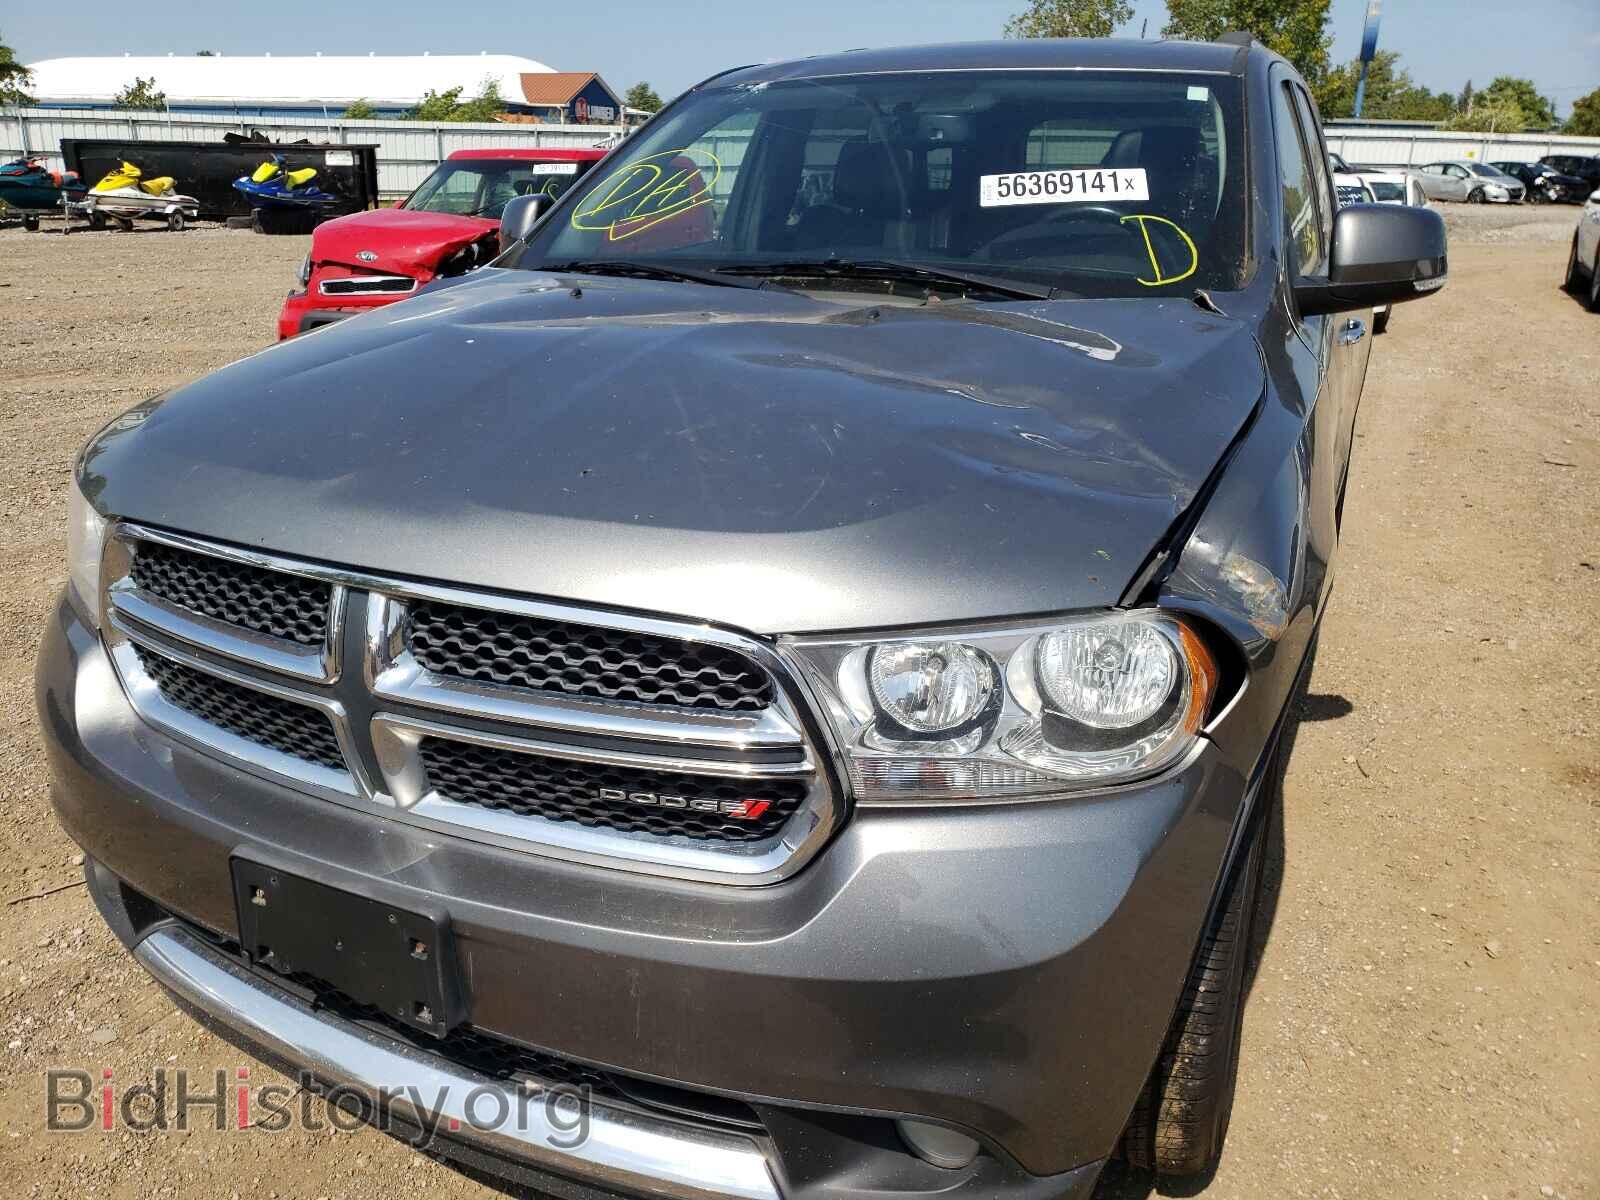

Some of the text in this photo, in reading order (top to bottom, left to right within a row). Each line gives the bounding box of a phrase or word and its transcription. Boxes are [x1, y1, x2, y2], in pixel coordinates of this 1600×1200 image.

[997, 171, 1119, 198] 56369141
[1119, 214, 1198, 286] D
[599, 787, 747, 815] DODGE
